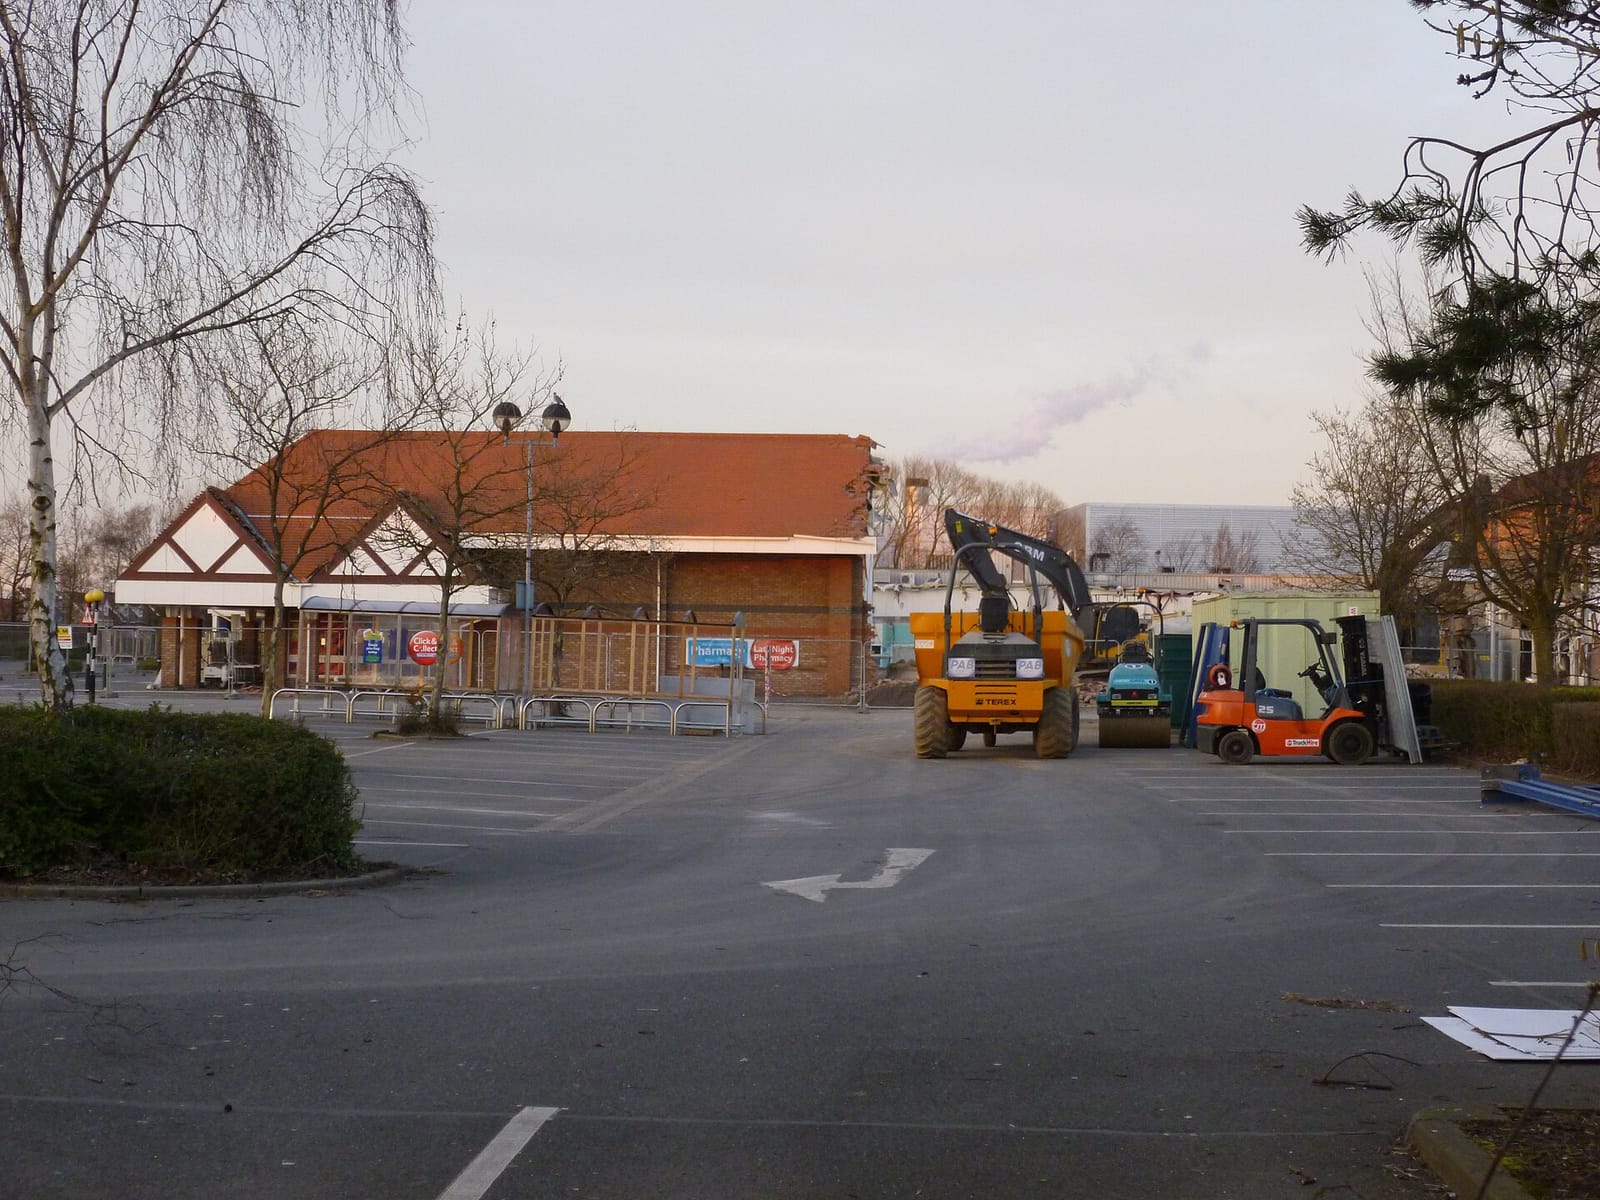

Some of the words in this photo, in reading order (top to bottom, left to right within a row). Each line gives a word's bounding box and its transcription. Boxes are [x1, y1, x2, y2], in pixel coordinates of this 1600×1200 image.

[772, 645, 794, 655] Night
[951, 660, 974, 670] PAB
[1019, 660, 1042, 670] PAB
[1258, 705, 1274, 714] 25
